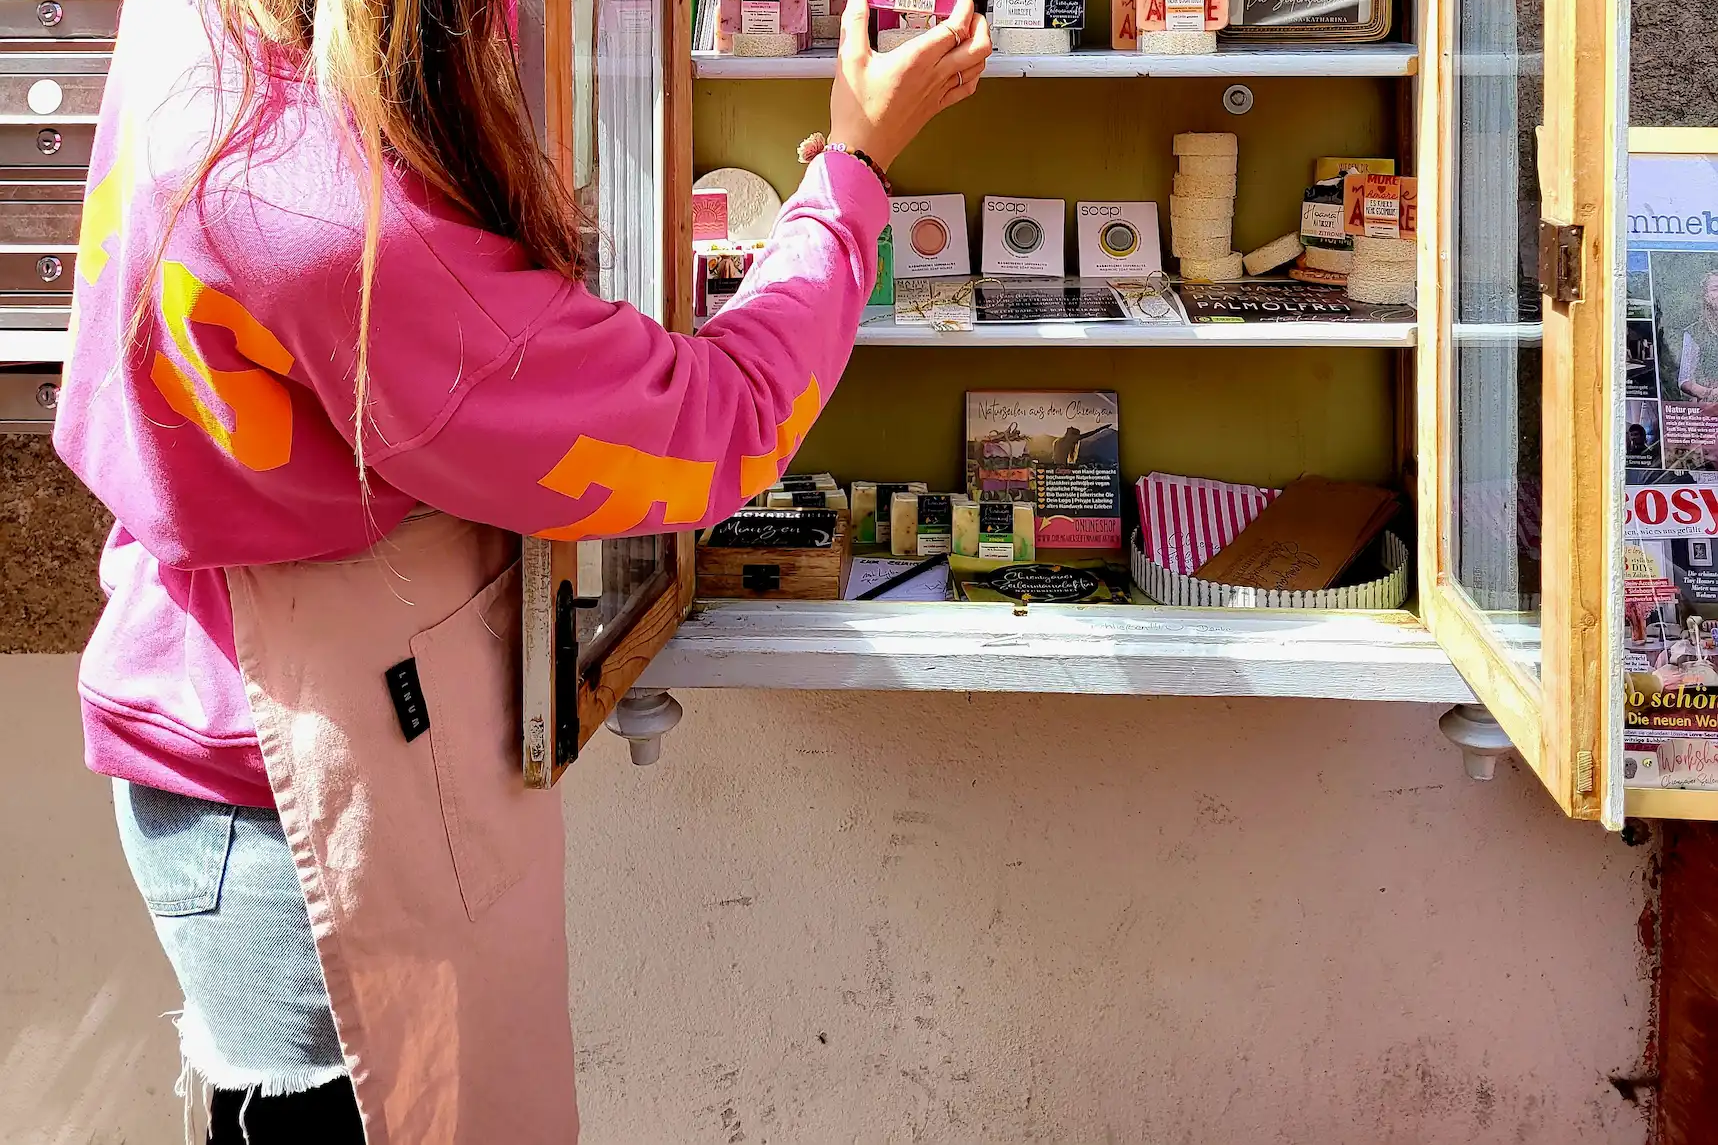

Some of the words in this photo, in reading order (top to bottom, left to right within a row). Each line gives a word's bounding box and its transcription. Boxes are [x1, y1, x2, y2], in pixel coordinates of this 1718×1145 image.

[1367, 175, 1398, 185] MORE
[892, 201, 932, 215] soapi
[988, 201, 1028, 215] soapi
[1081, 206, 1122, 218] soapi
[1029, 407, 1045, 420] aus
[1047, 404, 1063, 416] dem
[1665, 405, 1687, 414] Natur
[1688, 406, 1700, 415] pur
[399, 671, 420, 728] LINUM
[1628, 712, 1649, 726] Die
[1653, 716, 1692, 727] neuen
